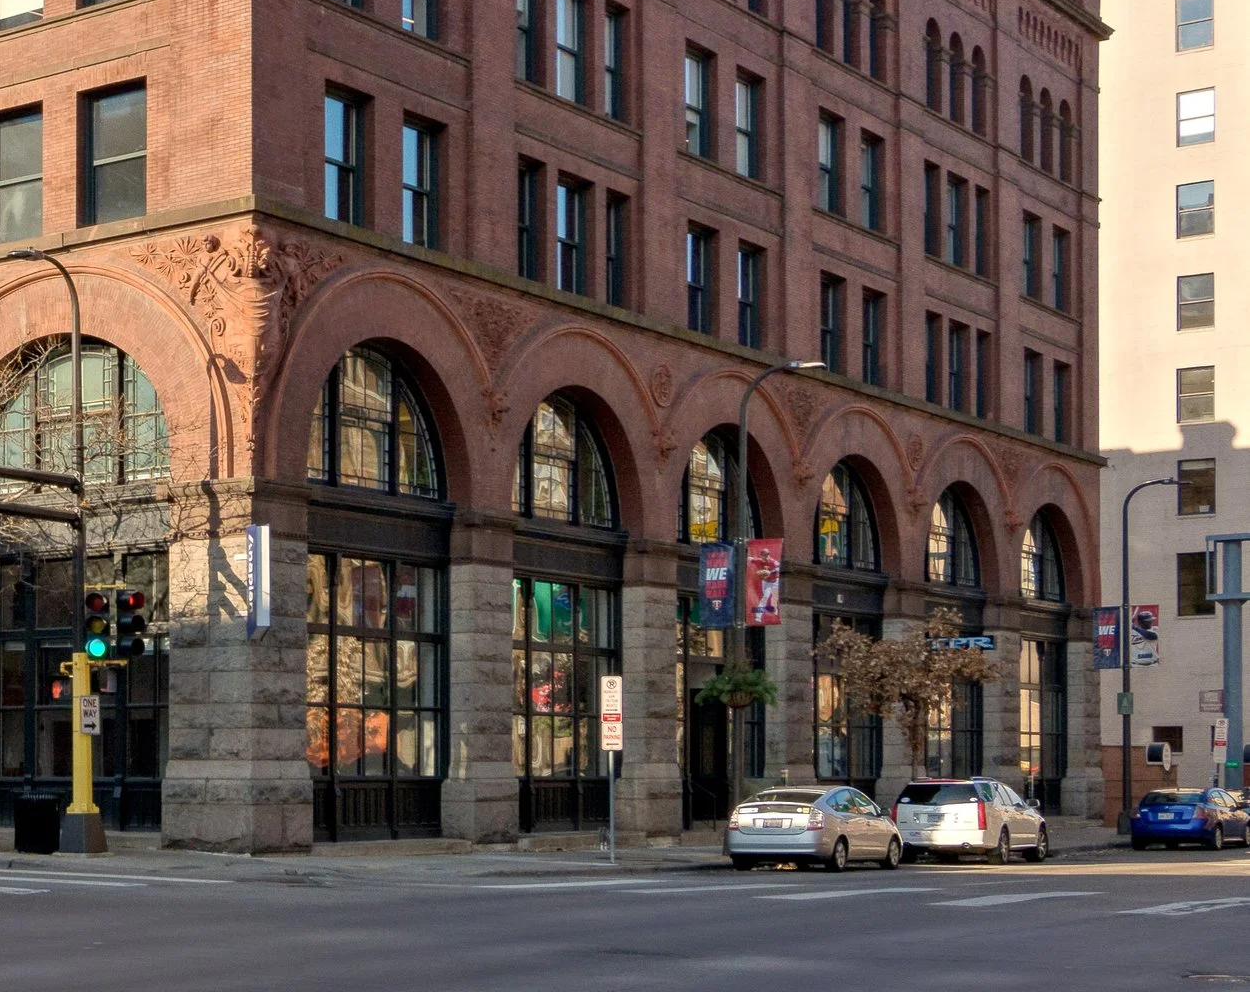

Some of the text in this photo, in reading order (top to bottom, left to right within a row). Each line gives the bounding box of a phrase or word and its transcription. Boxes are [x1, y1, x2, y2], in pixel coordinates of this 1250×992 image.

[705, 568, 727, 580] WE
[1098, 625, 1116, 636] WE
[83, 698, 97, 708] ONE
[83, 709, 97, 718] WAY
